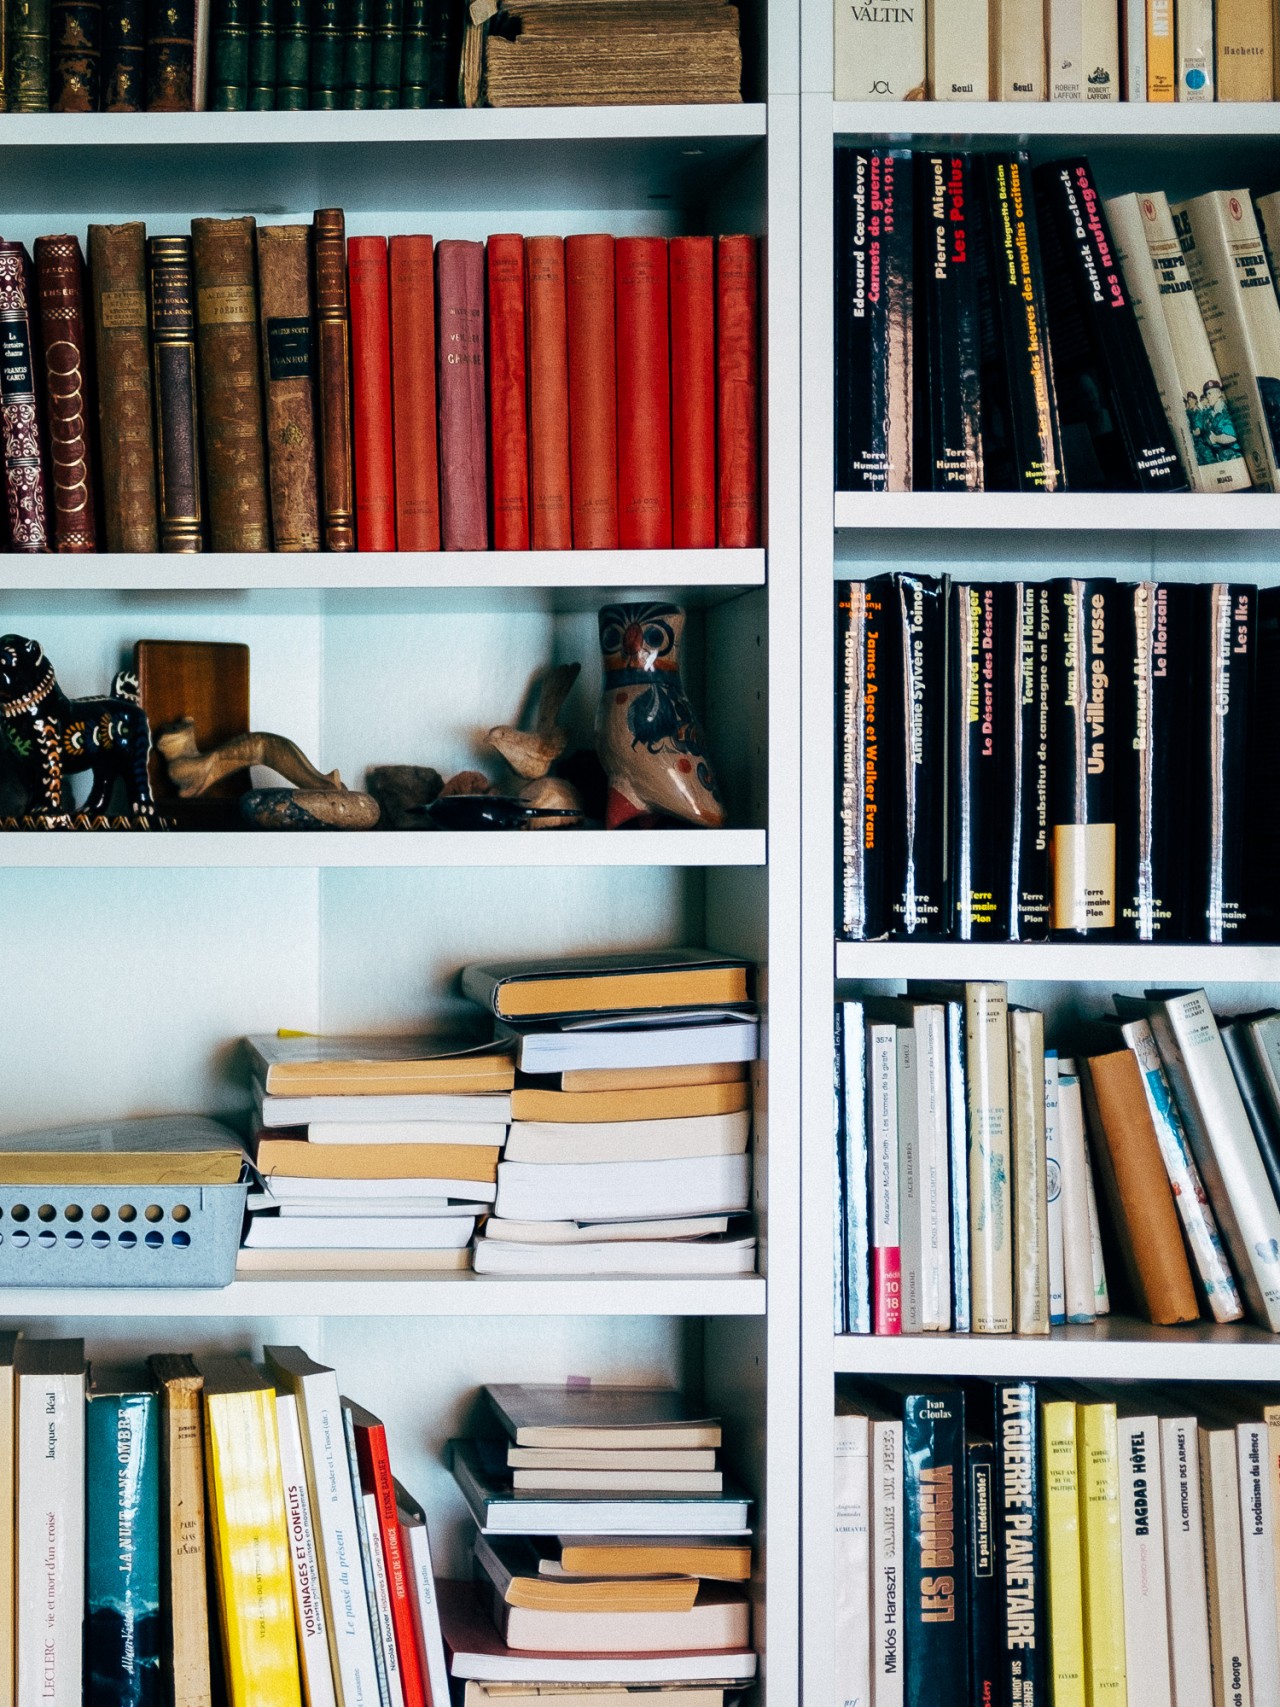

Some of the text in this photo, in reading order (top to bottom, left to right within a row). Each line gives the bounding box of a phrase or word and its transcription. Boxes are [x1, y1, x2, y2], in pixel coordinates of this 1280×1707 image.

[851, 7, 914, 23] VALTIN
[952, 83, 973, 93] Seuil
[1013, 82, 1033, 93] Seuil
[868, 156, 884, 302] Carnets de guerre
[885, 157, 893, 232] 1914-1918
[931, 159, 946, 279] Pierre Miquel
[950, 159, 966, 262] Les Poilus
[854, 155, 867, 317] Edouard Cœurdevey
[1060, 170, 1104, 302] Patrick Declerck
[1076, 167, 1124, 307] Les naufragés
[1138, 454, 1177, 470] Humaine
[1143, 446, 1165, 456] Terre
[1150, 465, 1170, 478] Plon
[982, 590, 993, 755] Le Désert des Déserts
[1154, 589, 1166, 677] Le Horsain
[1087, 594, 1109, 774] Un village russe
[865, 632, 879, 848] James Agee et Walker Evans
[886, 1282, 899, 1293] 10
[886, 1297, 899, 1308] 18
[919, 1409, 952, 1419] Cloulas
[927, 1400, 944, 1409] Ivan
[1130, 1431, 1149, 1535] BAGDAD HÔTEL
[1178, 1434, 1186, 1460] ARMES
[1002, 1388, 1035, 1650] LA GUERRE PLANETAIRE
[1180, 1481, 1189, 1517] CRITIQUE
[1182, 1520, 1189, 1531] LA
[288, 1485, 314, 1637] VOISINAGES ET CONFLITS
[388, 1528, 405, 1599] VERTIGE DE LA FORCE
[920, 1465, 954, 1622] LES BORGIA
[884, 1566, 896, 1673] Miklós Haraszti
